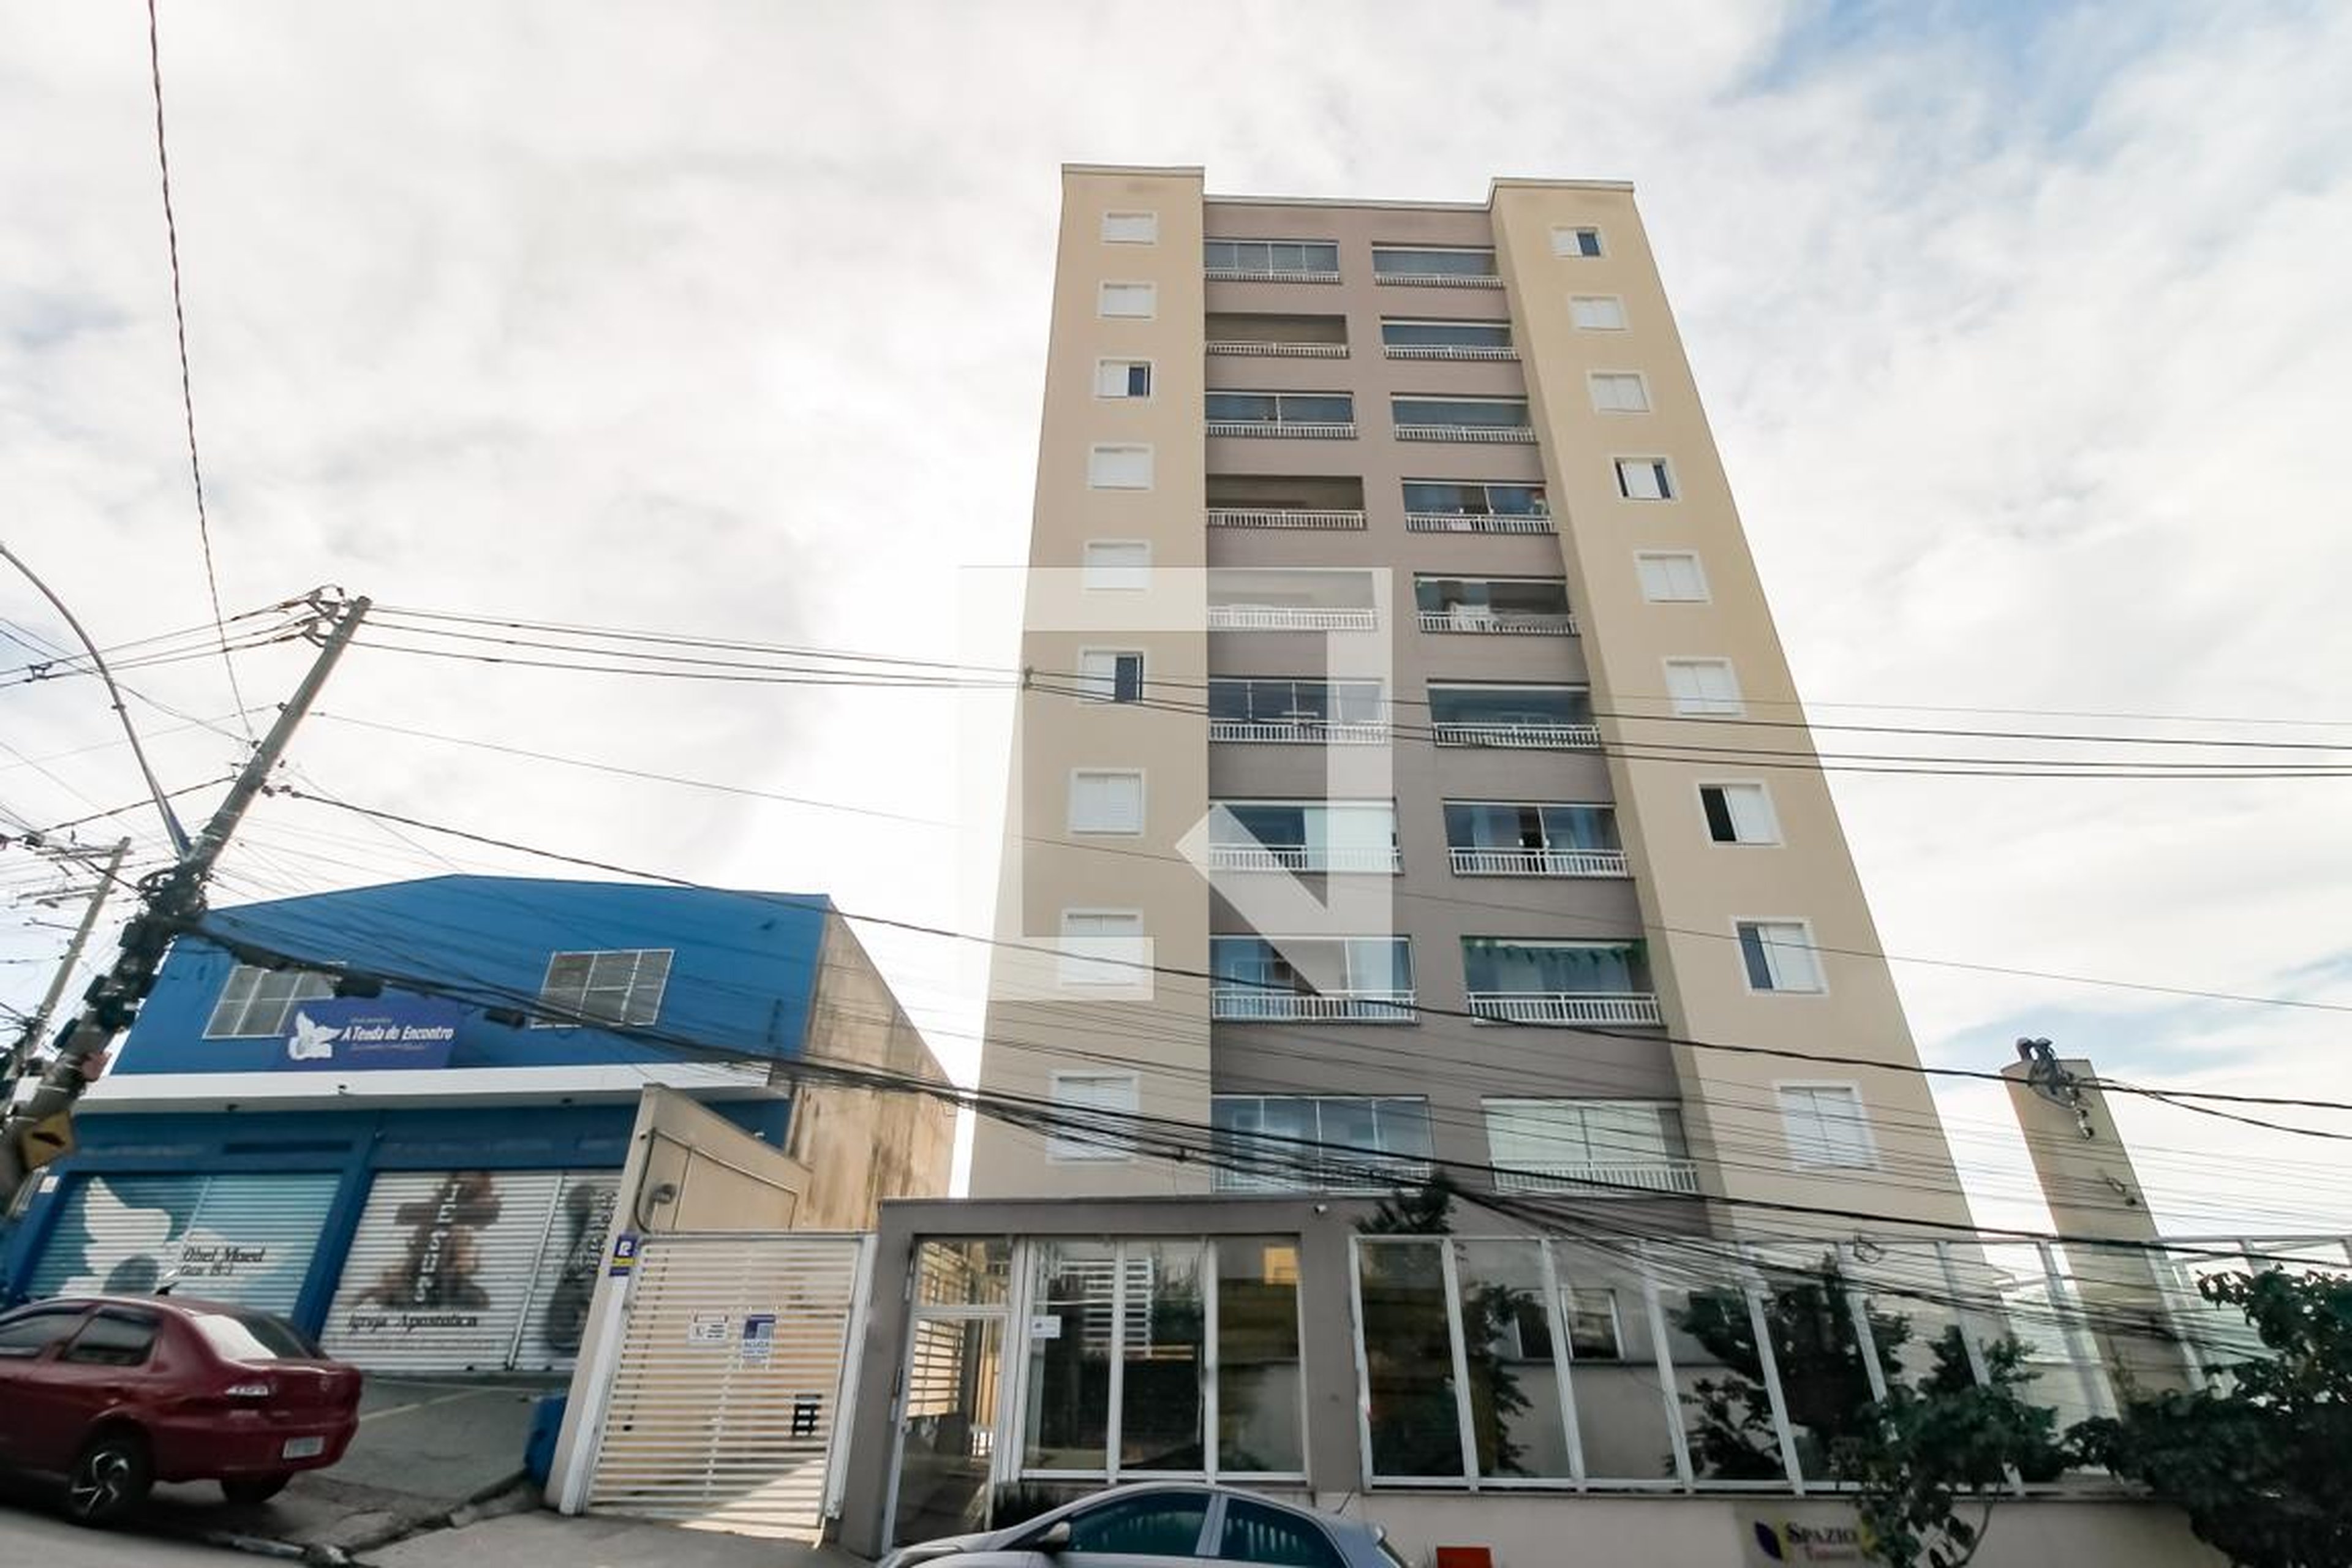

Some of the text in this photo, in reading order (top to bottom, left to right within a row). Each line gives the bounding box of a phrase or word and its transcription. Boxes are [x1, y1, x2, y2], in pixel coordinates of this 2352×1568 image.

[341, 1026, 352, 1041] A
[353, 1025, 385, 1041] Tenda
[401, 1025, 454, 1041] Encontro
